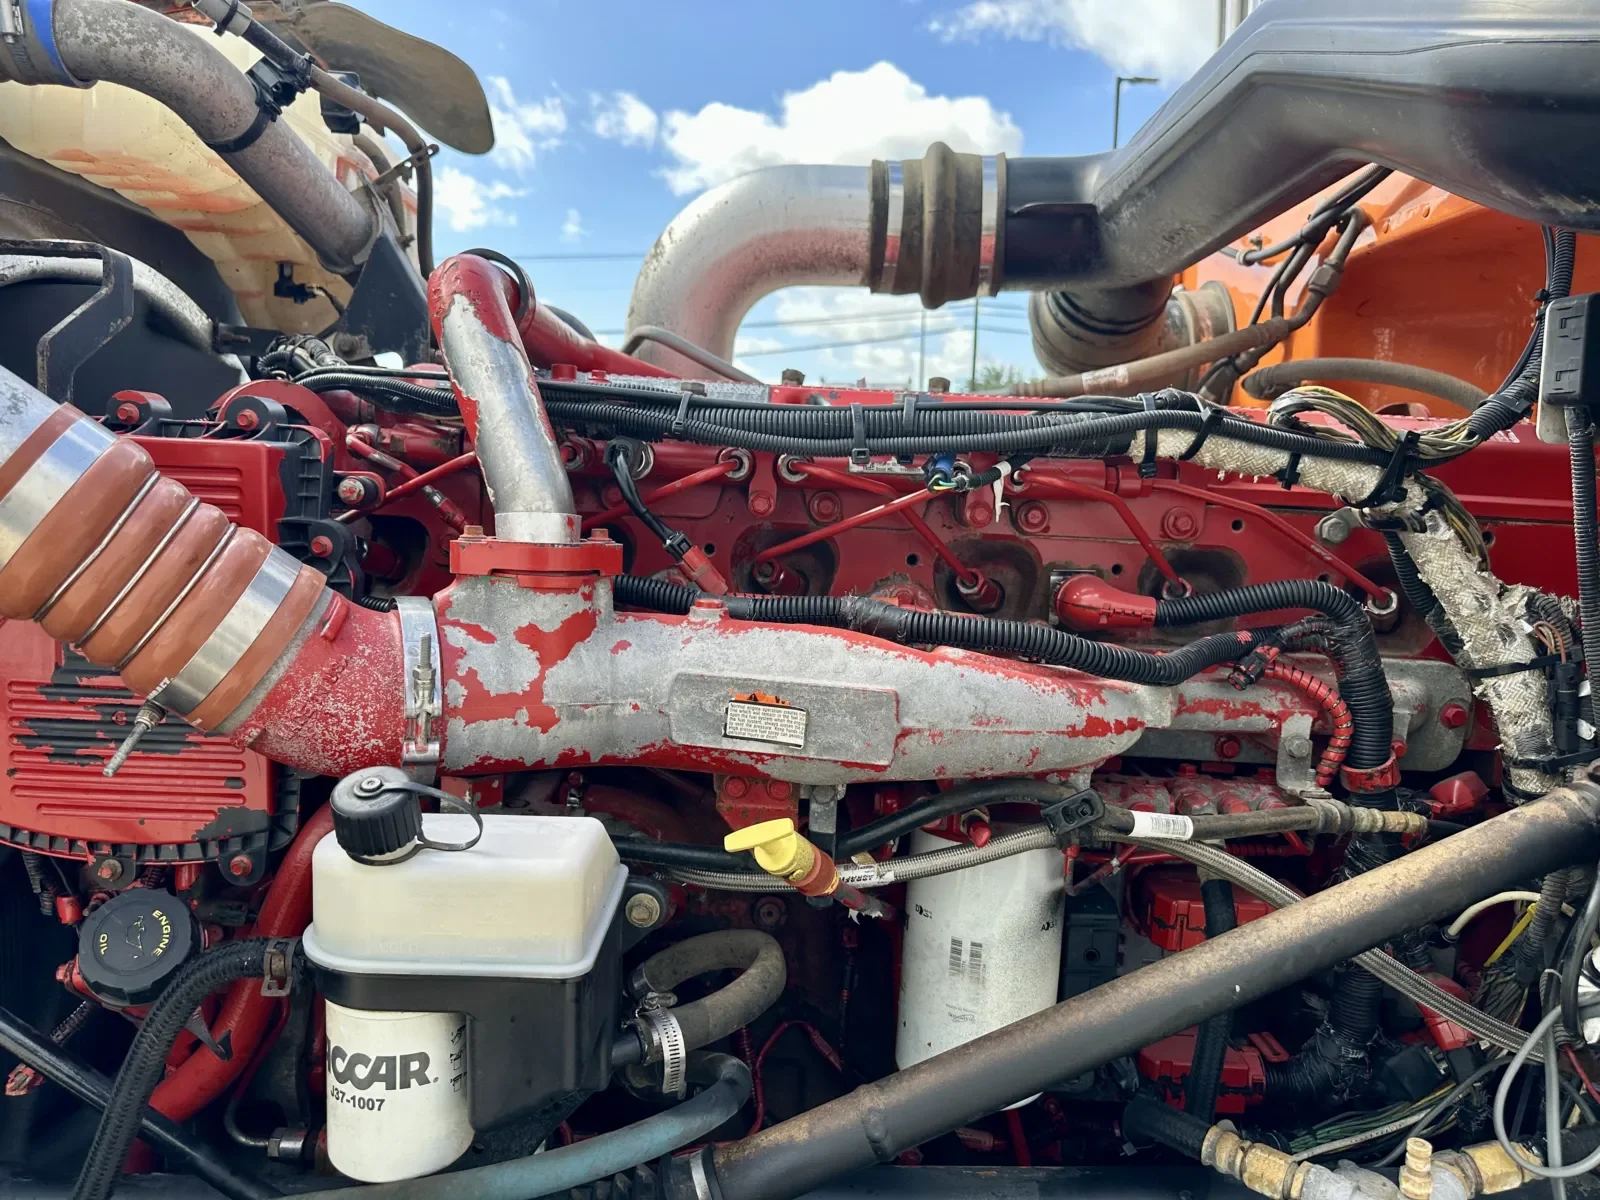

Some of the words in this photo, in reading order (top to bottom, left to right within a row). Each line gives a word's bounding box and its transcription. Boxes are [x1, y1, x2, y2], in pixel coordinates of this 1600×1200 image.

[100, 934, 108, 955] OIL
[152, 910, 170, 956] ENGINE
[326, 1036, 431, 1090] CCAR
